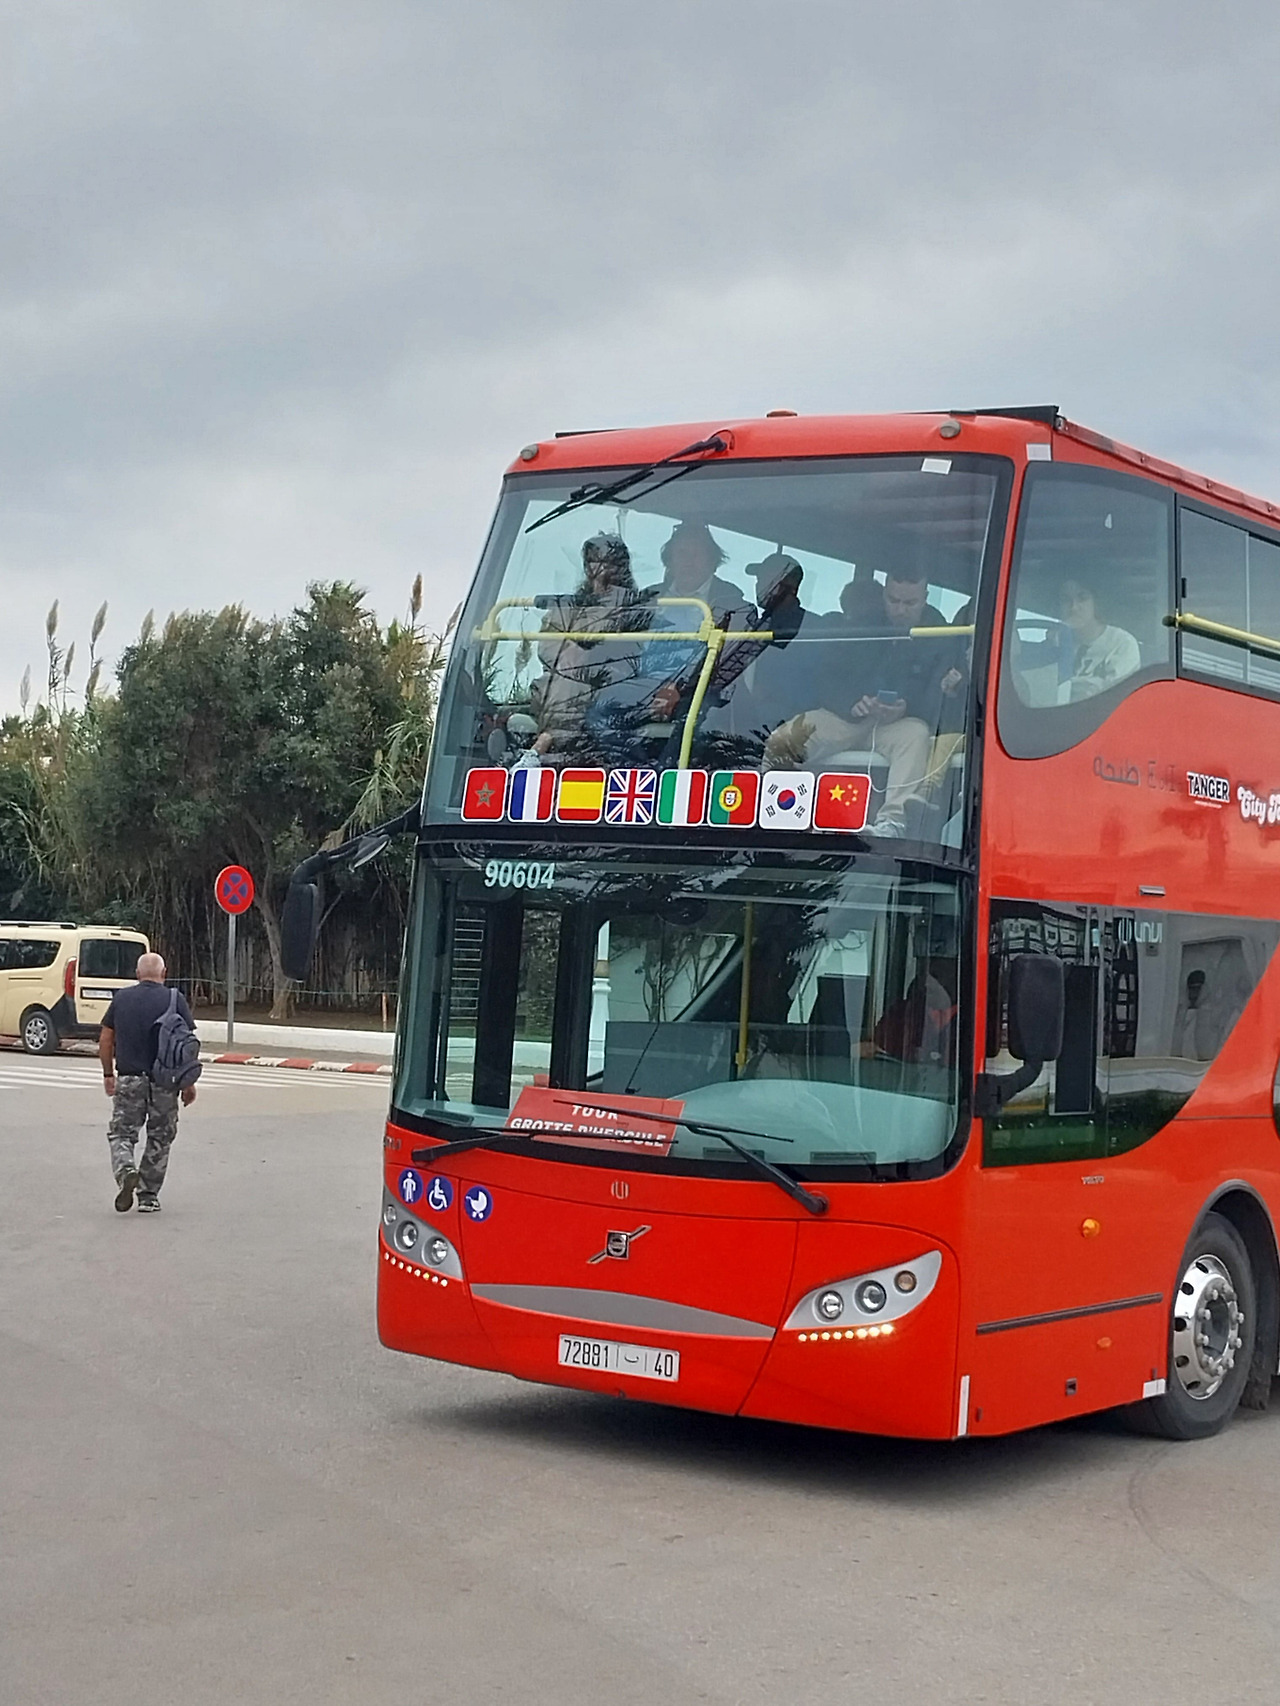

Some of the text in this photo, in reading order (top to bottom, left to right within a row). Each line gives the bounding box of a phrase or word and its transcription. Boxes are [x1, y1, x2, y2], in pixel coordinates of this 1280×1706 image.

[1187, 773, 1229, 802] TANGER
[1237, 786, 1266, 825] City
[484, 860, 556, 889] 90604
[564, 1339, 608, 1368] 72881
[654, 1352, 673, 1377] 40
